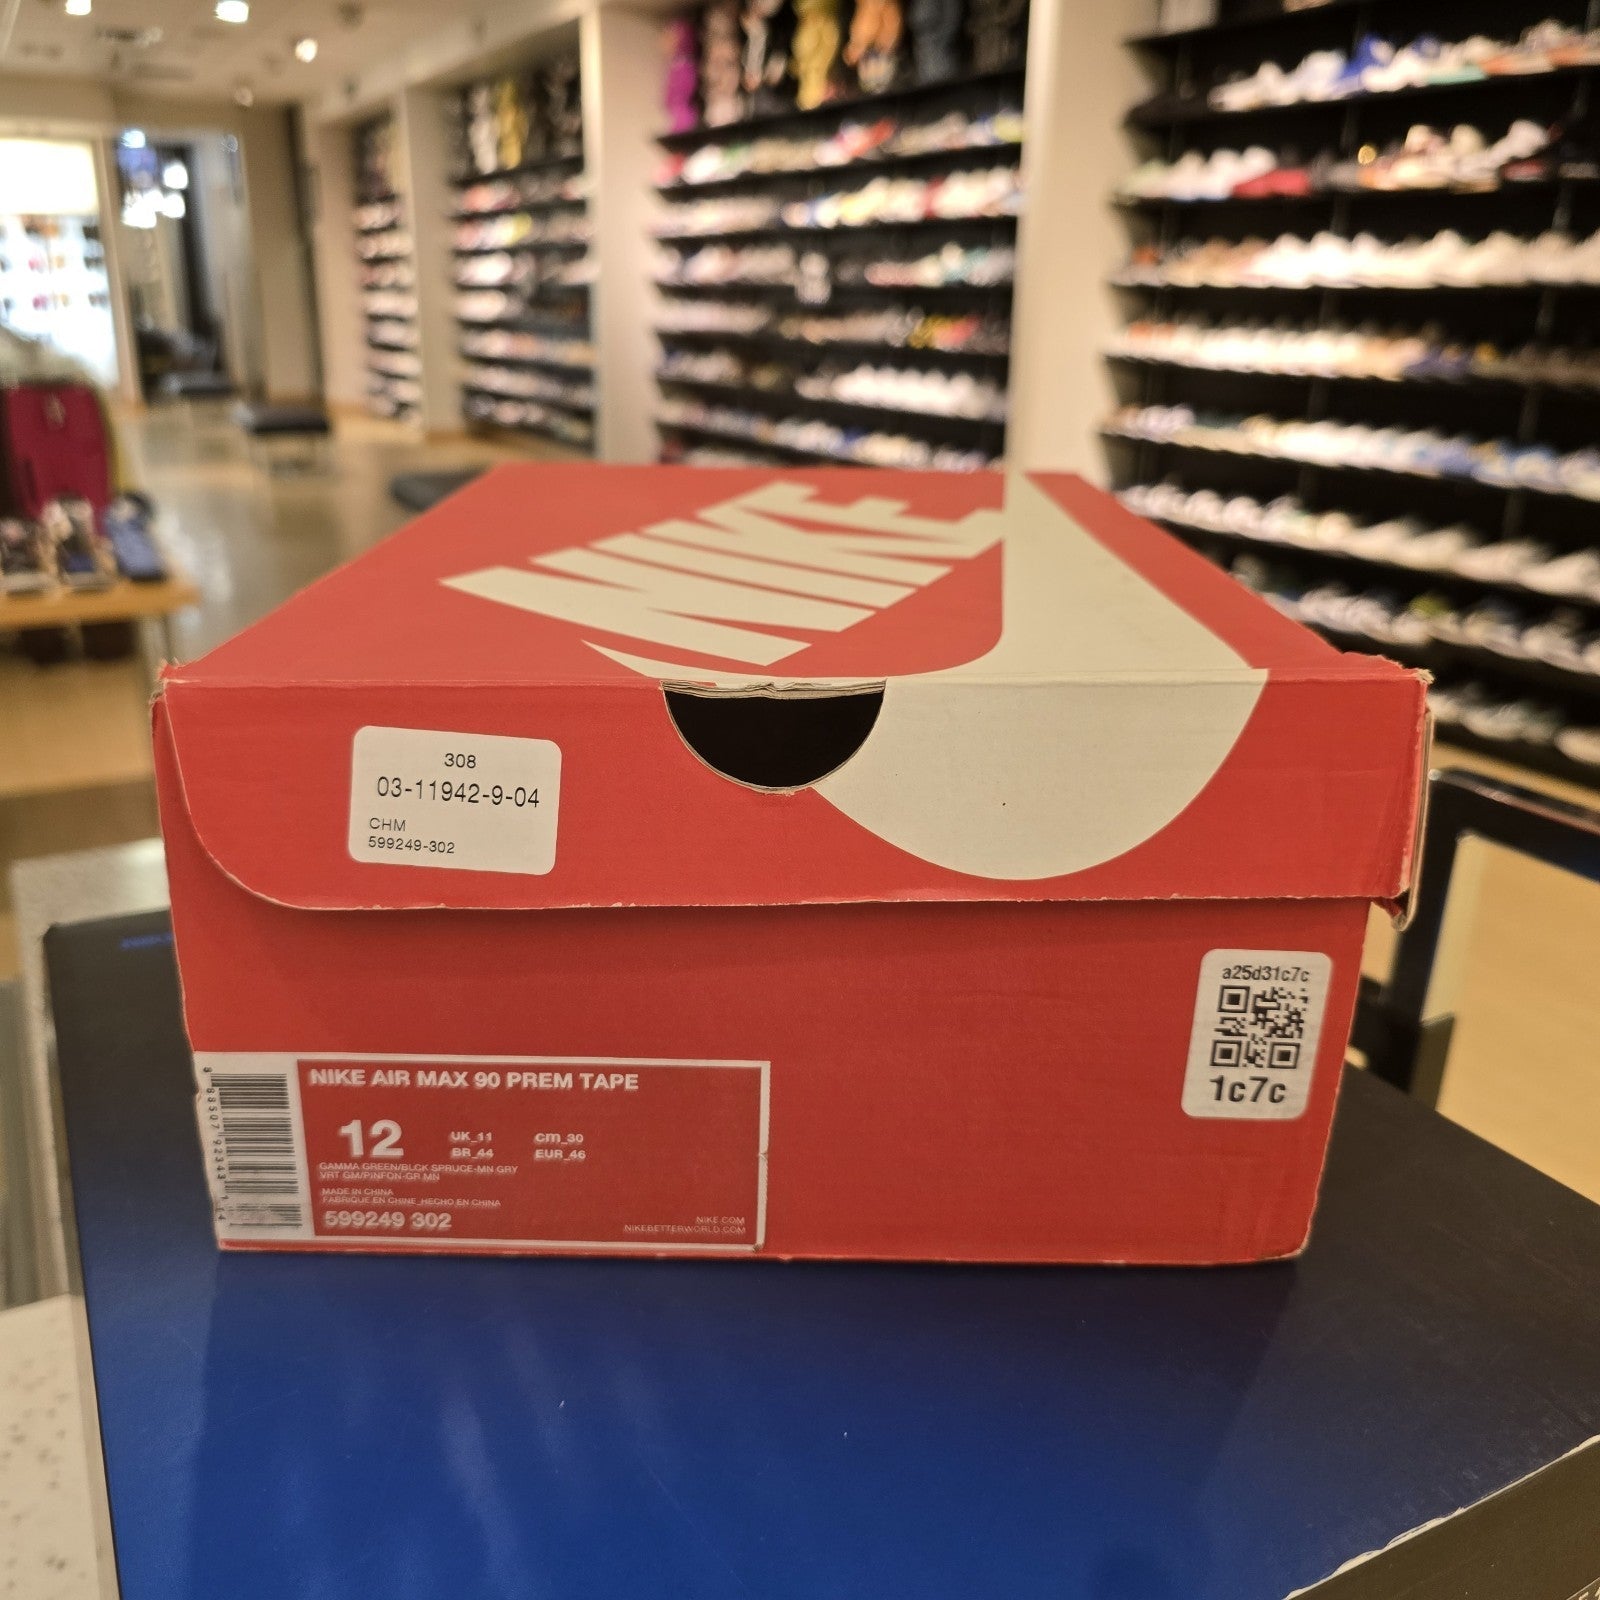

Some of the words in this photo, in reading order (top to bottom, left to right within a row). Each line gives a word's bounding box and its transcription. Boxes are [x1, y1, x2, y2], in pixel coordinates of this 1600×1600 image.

[438, 480, 1004, 667] NIKE
[444, 752, 477, 769] 308
[376, 776, 540, 808] 03-11942-9-04
[369, 817, 406, 832] CHM
[368, 836, 455, 854] 599249-302
[1222, 965, 1310, 982] a25d31c7c
[309, 1068, 366, 1086] NIKE
[371, 1069, 411, 1086] AIR
[416, 1070, 469, 1087] MAX
[474, 1071, 501, 1088] 90
[506, 1072, 573, 1089] PREM
[579, 1073, 639, 1090] TAPE
[1210, 1075, 1287, 1104] 1c7c
[339, 1119, 405, 1157] 12
[319, 1161, 360, 1171] GAMMA
[362, 1162, 429, 1173] GREEN/BLCK
[431, 1164, 494, 1174] SPRUCE-MN
[496, 1165, 519, 1174] GRY
[319, 1171, 340, 1180] VRT
[321, 1187, 350, 1196] MADE
[351, 1188, 362, 1196] IN
[364, 1188, 394, 1197] CHINA
[322, 1196, 370, 1205] FABRIQUE
[372, 1196, 386, 1205] EN
[456, 1198, 470, 1207] EN
[471, 1199, 502, 1208] CHINA
[324, 1210, 405, 1228] 599249
[411, 1211, 452, 1229] 302
